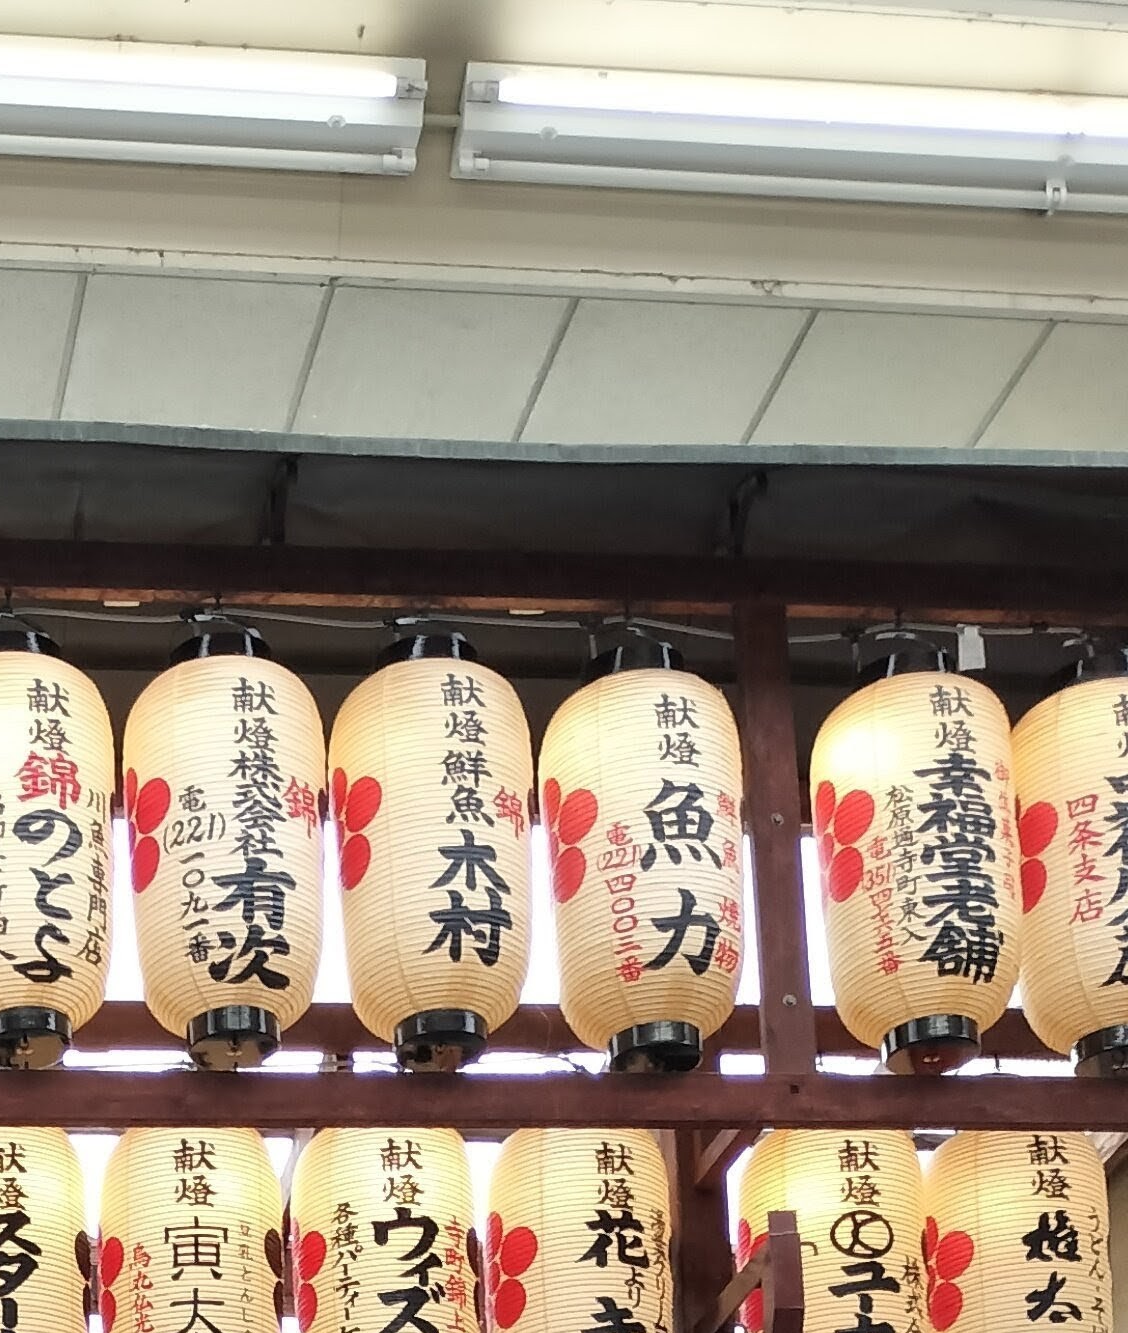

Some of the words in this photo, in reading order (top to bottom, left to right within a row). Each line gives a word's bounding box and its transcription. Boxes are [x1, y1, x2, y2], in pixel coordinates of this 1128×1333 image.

[28, 679, 72, 756] 献燈
[232, 677, 279, 752] 献燈
[441, 674, 489, 747] 献燈
[654, 694, 703, 768] 献燈
[929, 685, 977, 754] 献燈
[15, 752, 82, 809] 錦
[428, 749, 514, 967] 鮮魚木村
[640, 777, 723, 976] 魚力
[913, 752, 1003, 985] 幸福堂老舗
[1066, 793, 1108, 925] 四条支店
[12, 808, 83, 984] のとよ
[172, 1139, 216, 1208] 献燈
[380, 1139, 425, 1208] 献燈
[595, 1142, 635, 1211] 献燈
[838, 1139, 881, 1207] 献燈
[1027, 1135, 1072, 1200] 献燈
